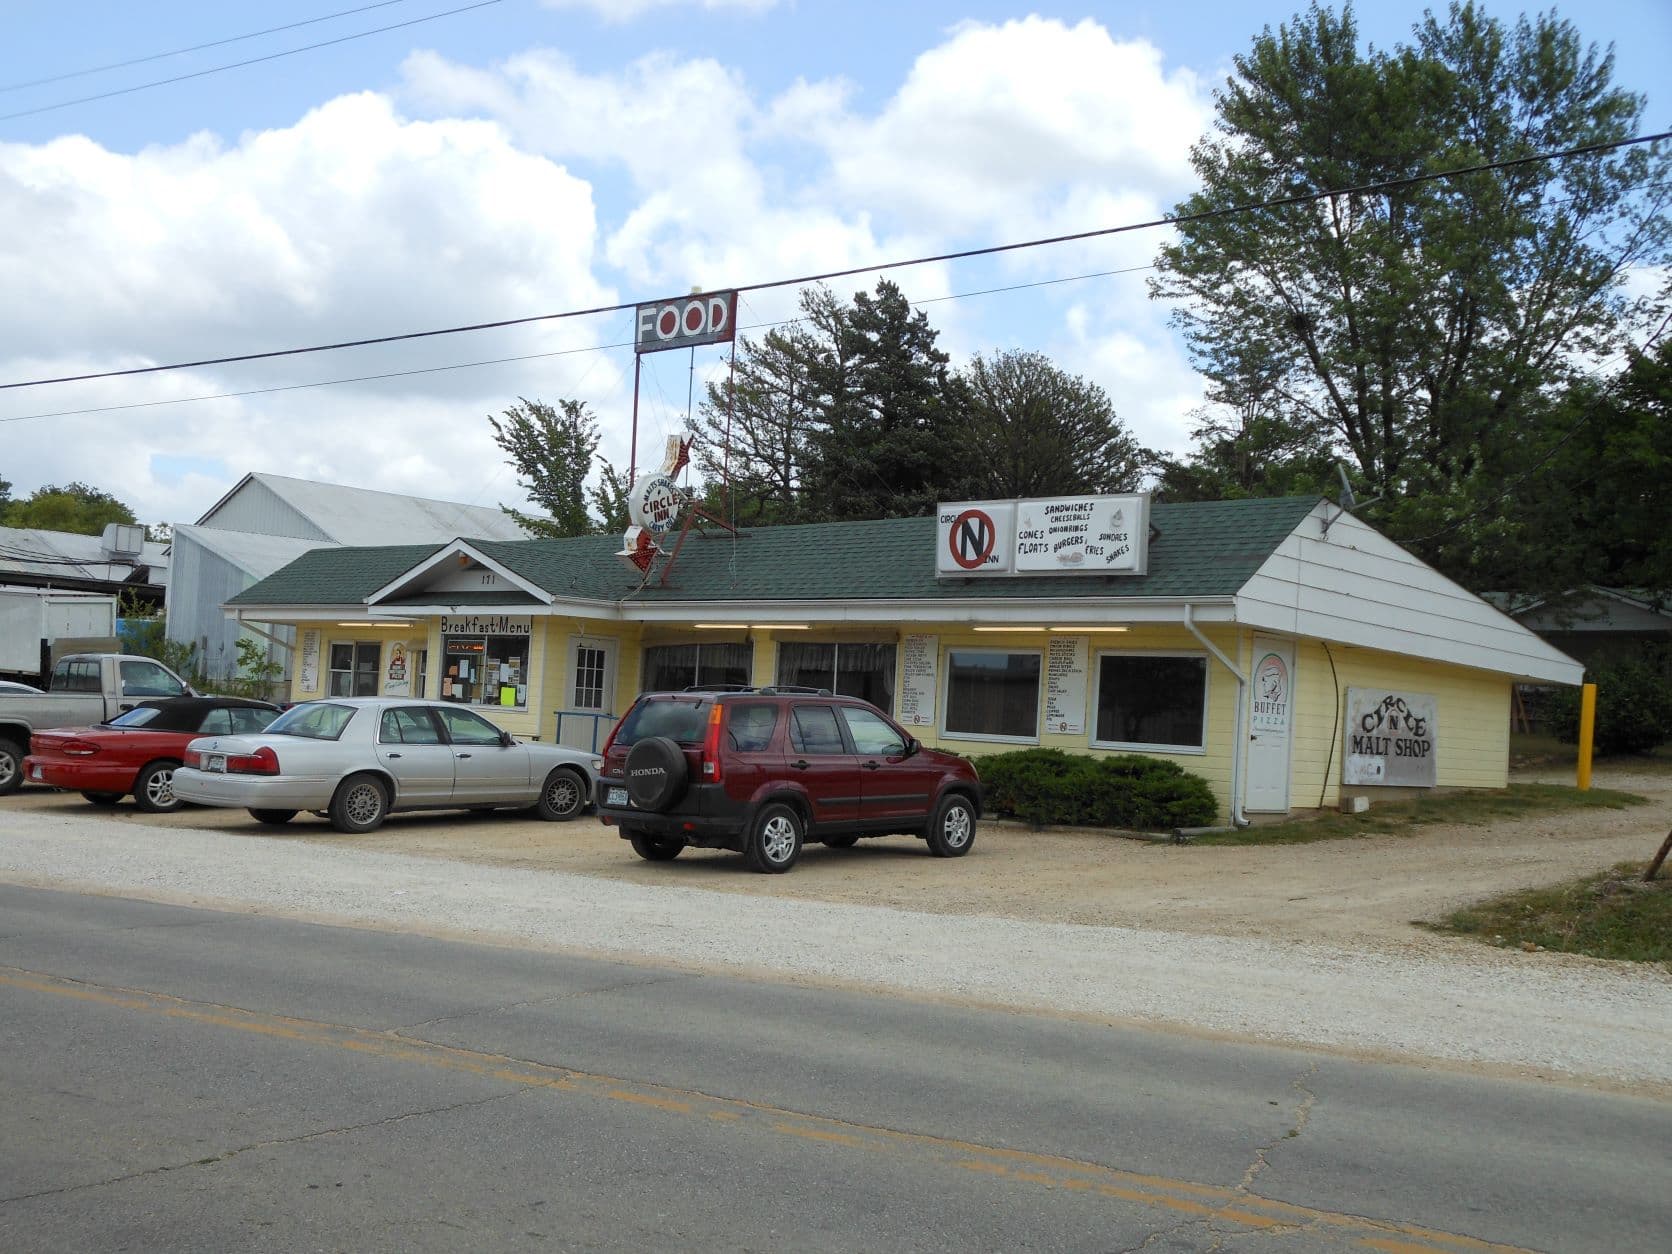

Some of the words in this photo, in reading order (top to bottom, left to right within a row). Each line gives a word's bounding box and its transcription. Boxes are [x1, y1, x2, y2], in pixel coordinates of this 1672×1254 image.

[637, 297, 728, 346] FOOD
[643, 480, 658, 502] MALTS
[642, 493, 678, 515] CIRCLE
[1045, 502, 1095, 515] SANDWICHES
[654, 507, 670, 523] INN
[940, 514, 961, 524] CIRC
[648, 520, 665, 532] CARRY
[961, 519, 985, 561] N
[1018, 530, 1044, 540] CONES
[1018, 542, 1049, 555] FLOATS
[1085, 545, 1104, 556] FRIES
[1106, 544, 1130, 564] SHAKES
[441, 615, 496, 634] Breakfast
[499, 615, 530, 634] Menu
[1254, 701, 1287, 716] BUFFET
[1252, 715, 1285, 726] PIZZA
[1361, 695, 1426, 738] CIRCLE
[1388, 715, 1399, 730] N
[1351, 735, 1392, 756] MALT
[1395, 738, 1431, 758] SHOP
[630, 767, 667, 777] HONDA
